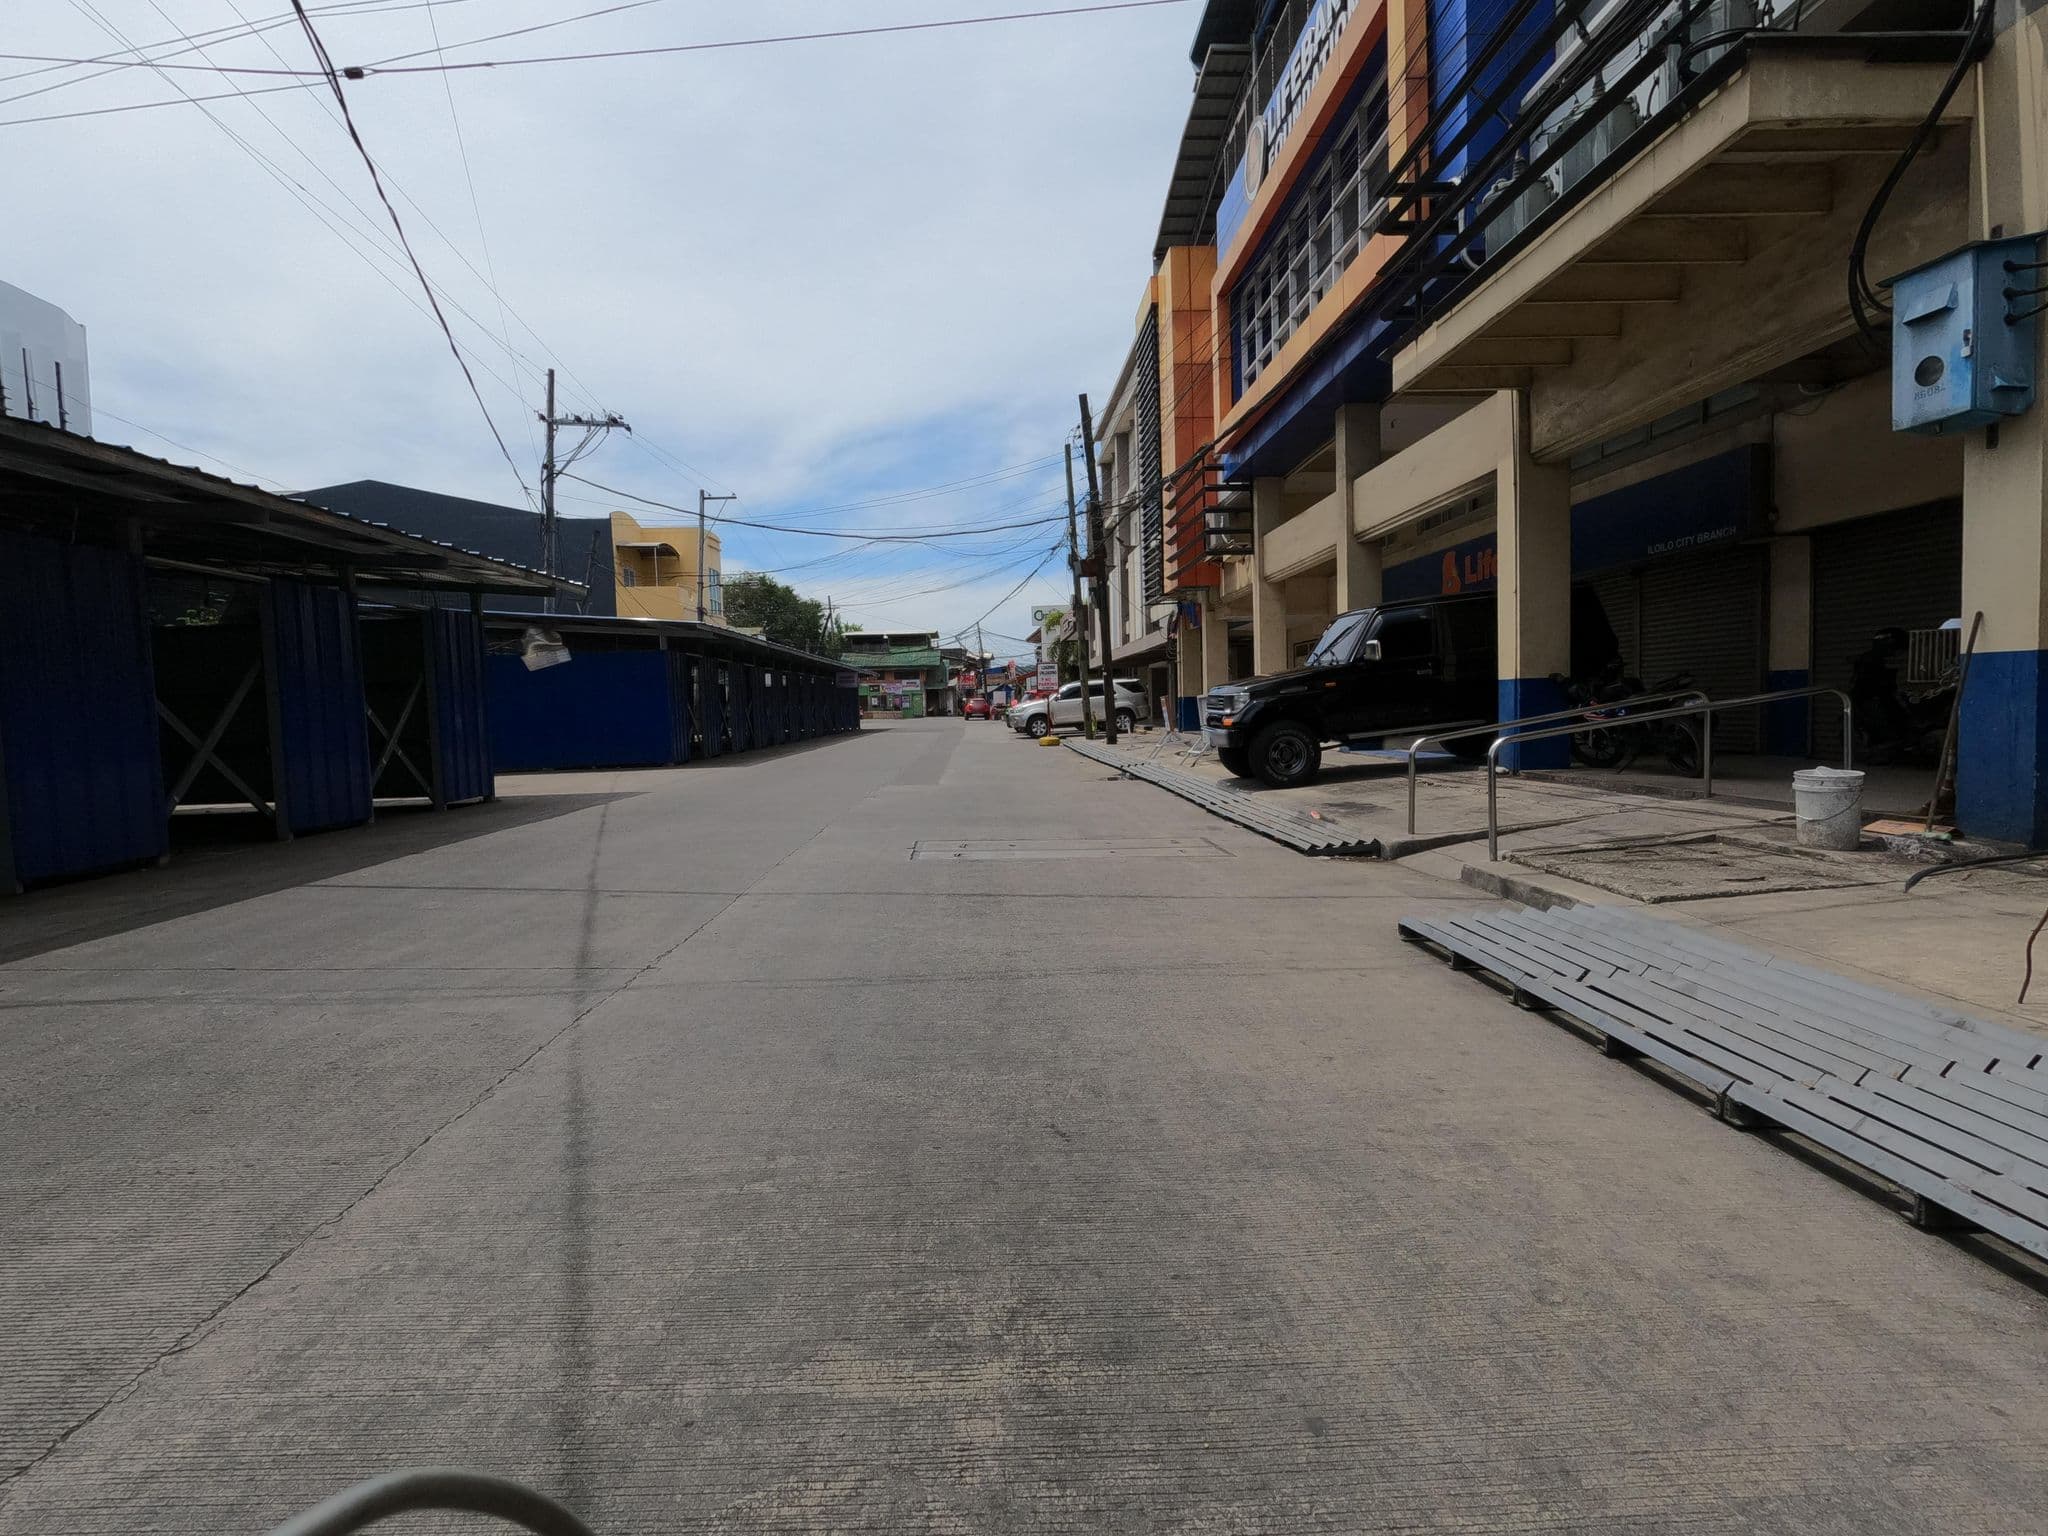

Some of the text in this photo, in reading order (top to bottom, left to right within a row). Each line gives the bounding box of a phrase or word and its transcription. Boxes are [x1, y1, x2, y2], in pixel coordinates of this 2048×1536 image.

[1647, 526, 1737, 554] ILOILO CITY BRANCH
